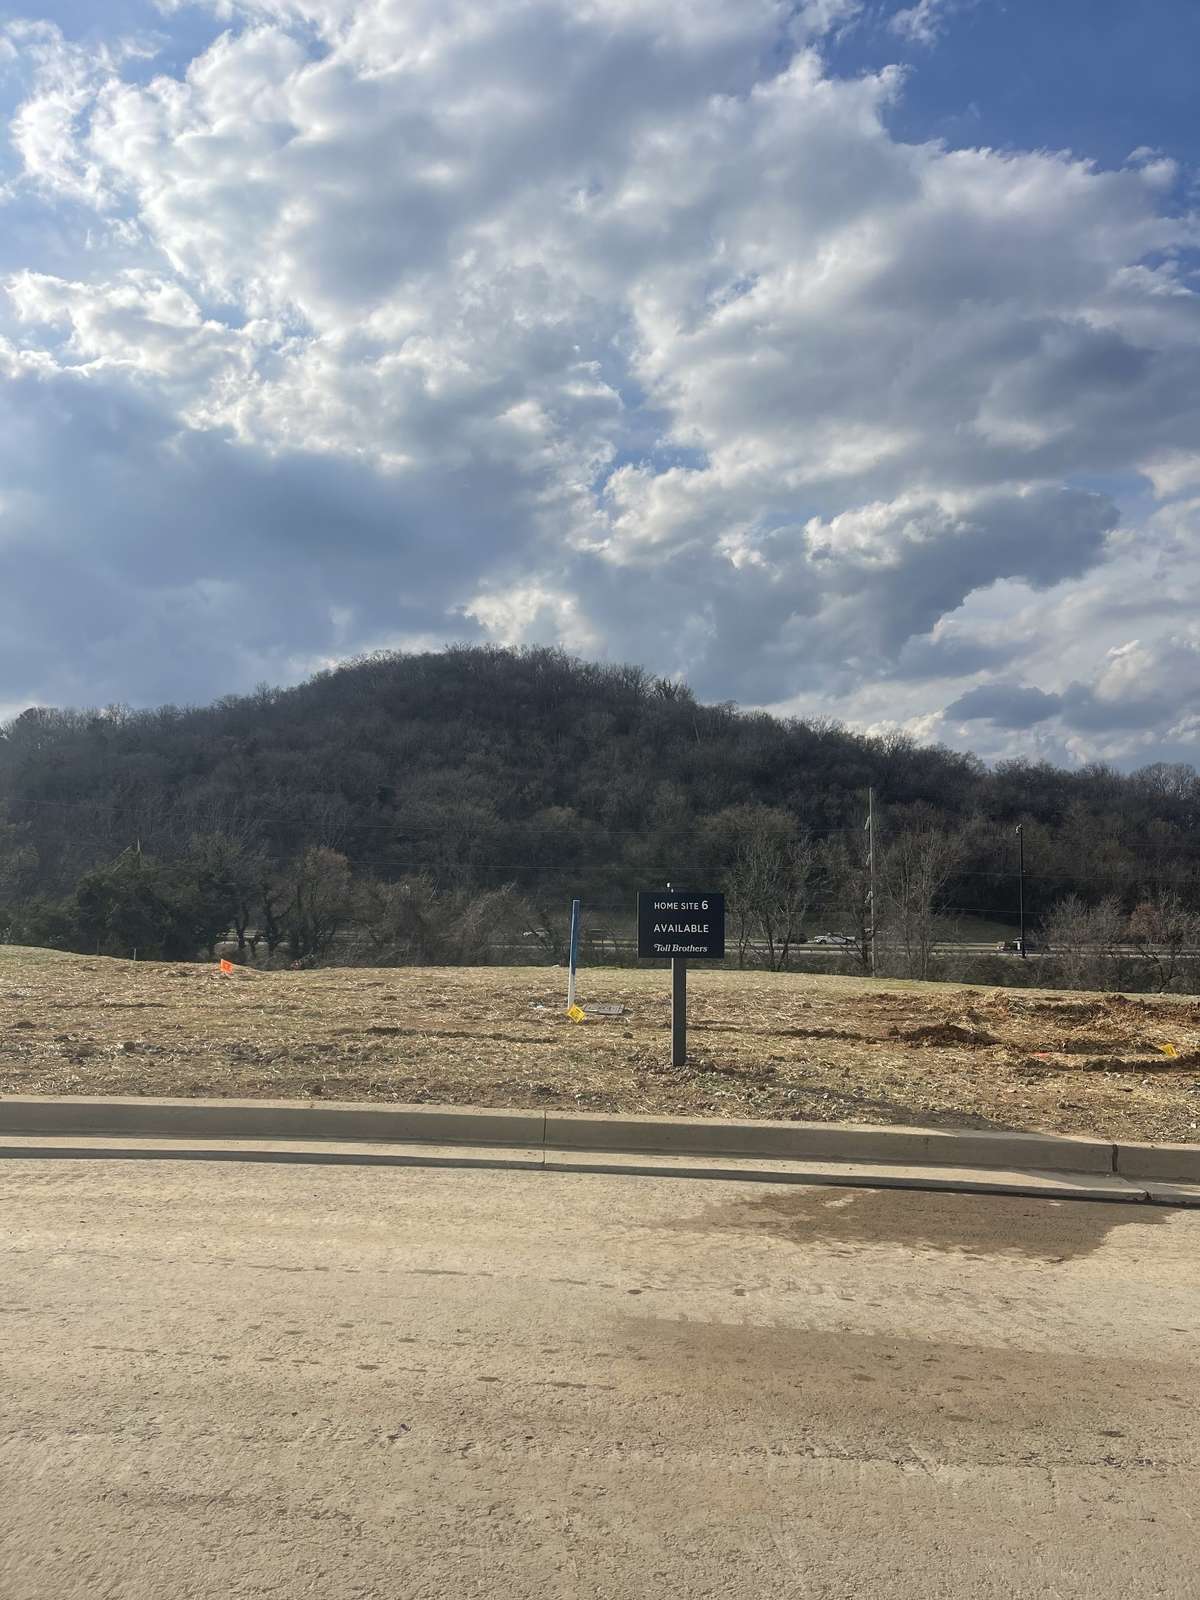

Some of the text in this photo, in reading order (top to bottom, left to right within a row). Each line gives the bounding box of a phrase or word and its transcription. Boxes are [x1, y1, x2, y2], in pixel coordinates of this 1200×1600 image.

[654, 900, 709, 910] HOME SITE 6
[653, 923, 709, 933] AVAILABLE
[653, 943, 708, 952] Toll Brothers
